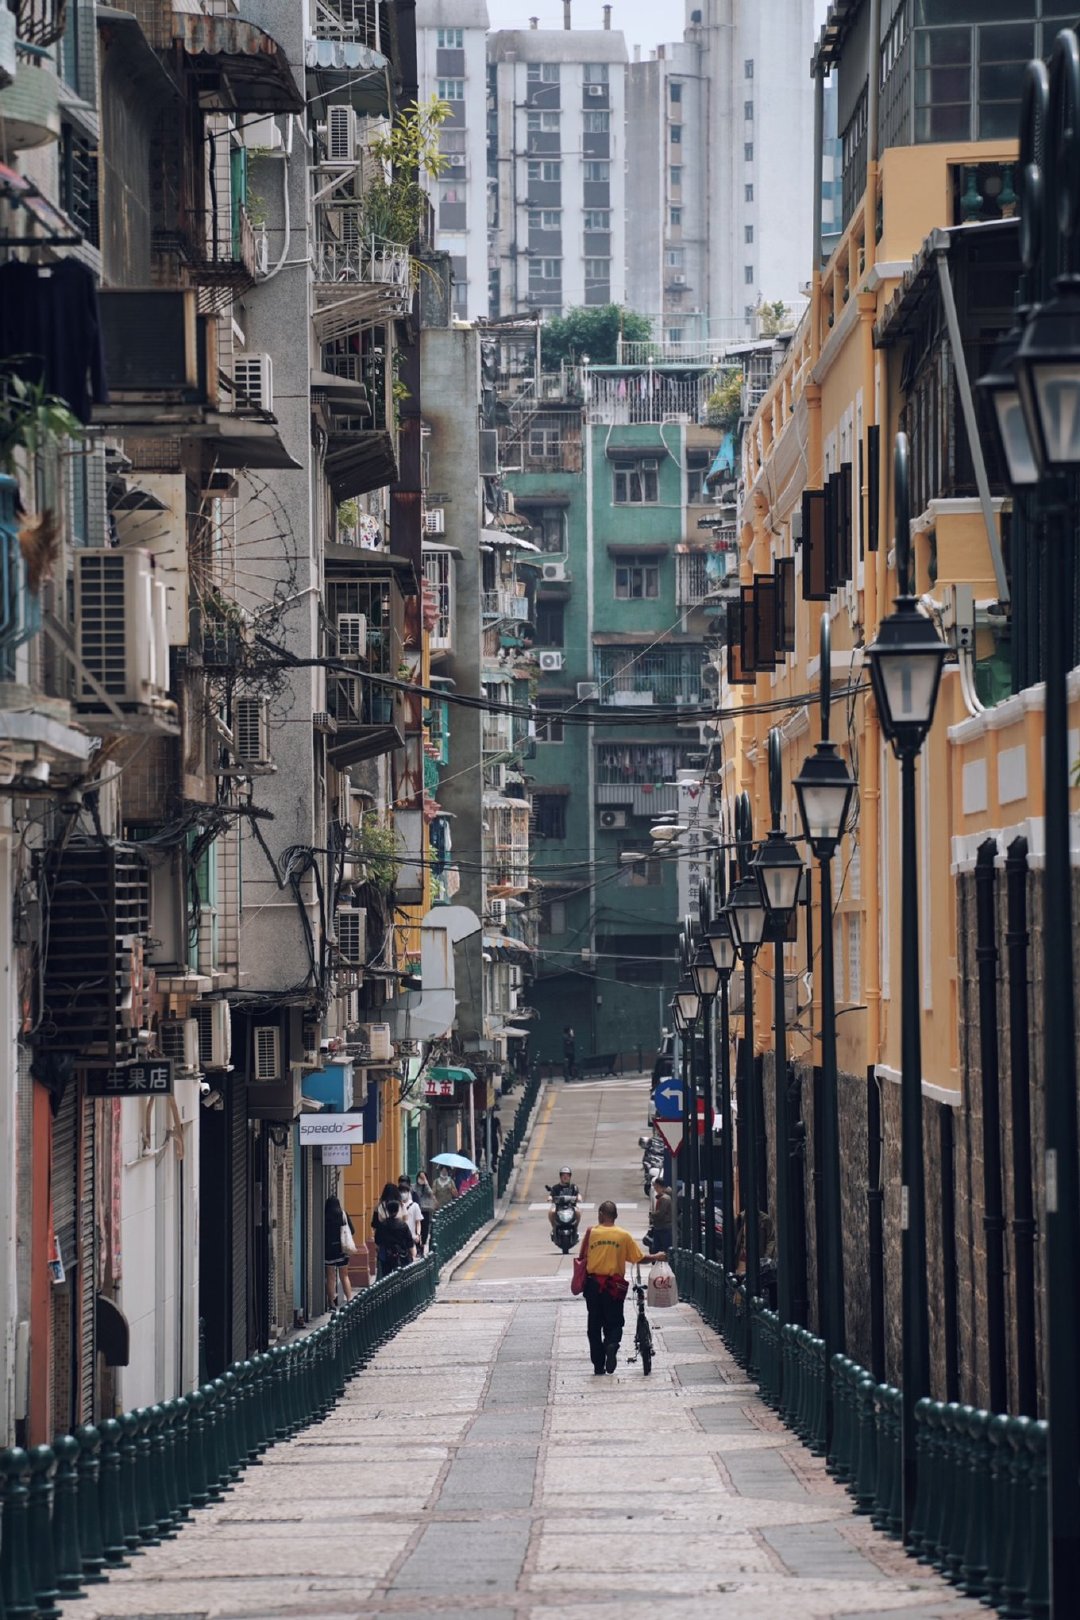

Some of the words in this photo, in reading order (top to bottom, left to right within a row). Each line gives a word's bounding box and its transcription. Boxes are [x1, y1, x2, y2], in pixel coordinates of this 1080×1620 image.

[106, 1067, 168, 1089] 生果店
[425, 1080, 452, 1096] 五金
[301, 1123, 343, 1136] speedo
